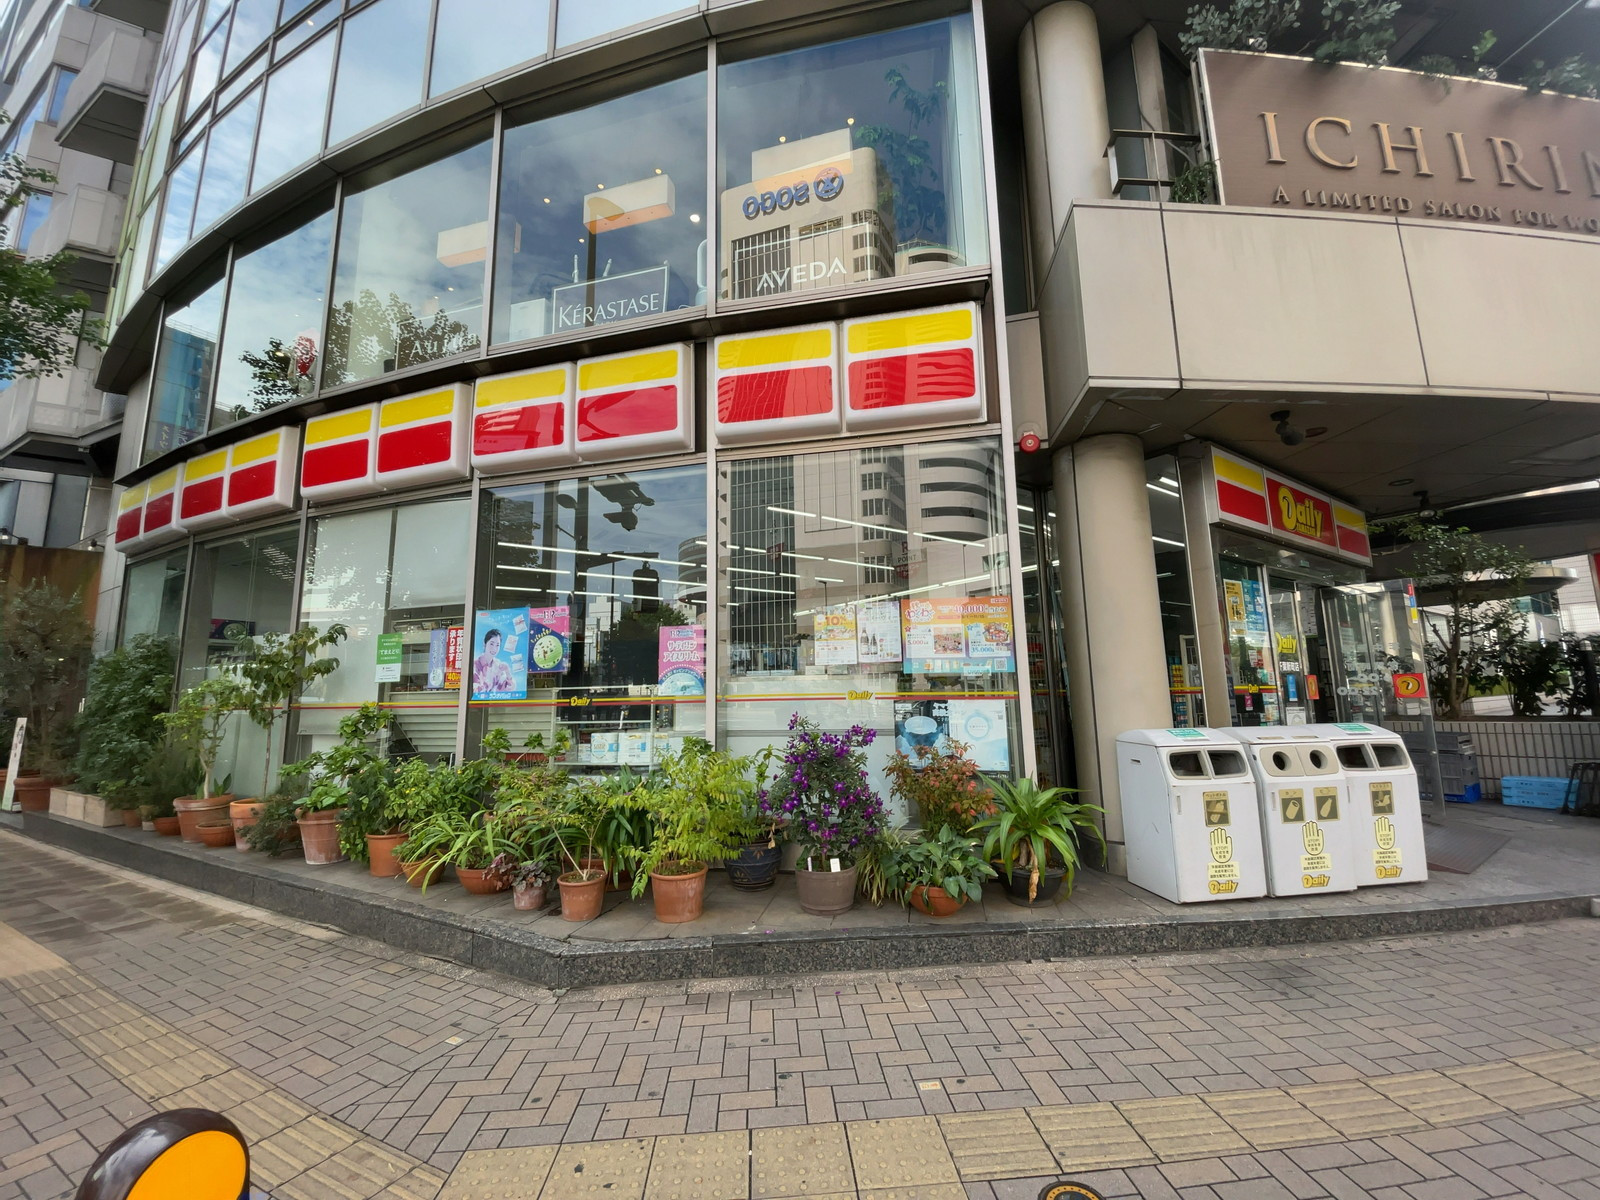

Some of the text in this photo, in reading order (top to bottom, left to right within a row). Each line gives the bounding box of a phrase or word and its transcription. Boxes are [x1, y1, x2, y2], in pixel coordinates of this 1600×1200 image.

[1273, 185, 1291, 204] A
[1302, 189, 1413, 213] LIMITED
[1424, 199, 1502, 222] SALON
[1514, 208, 1558, 228] FOR
[756, 257, 847, 292] AVEDA
[559, 293, 660, 328] KÉRASTASE
[1278, 485, 1323, 539] Daily
[1208, 879, 1239, 895] Daily
[1301, 874, 1331, 889] Daily
[1375, 865, 1403, 880] Daily
